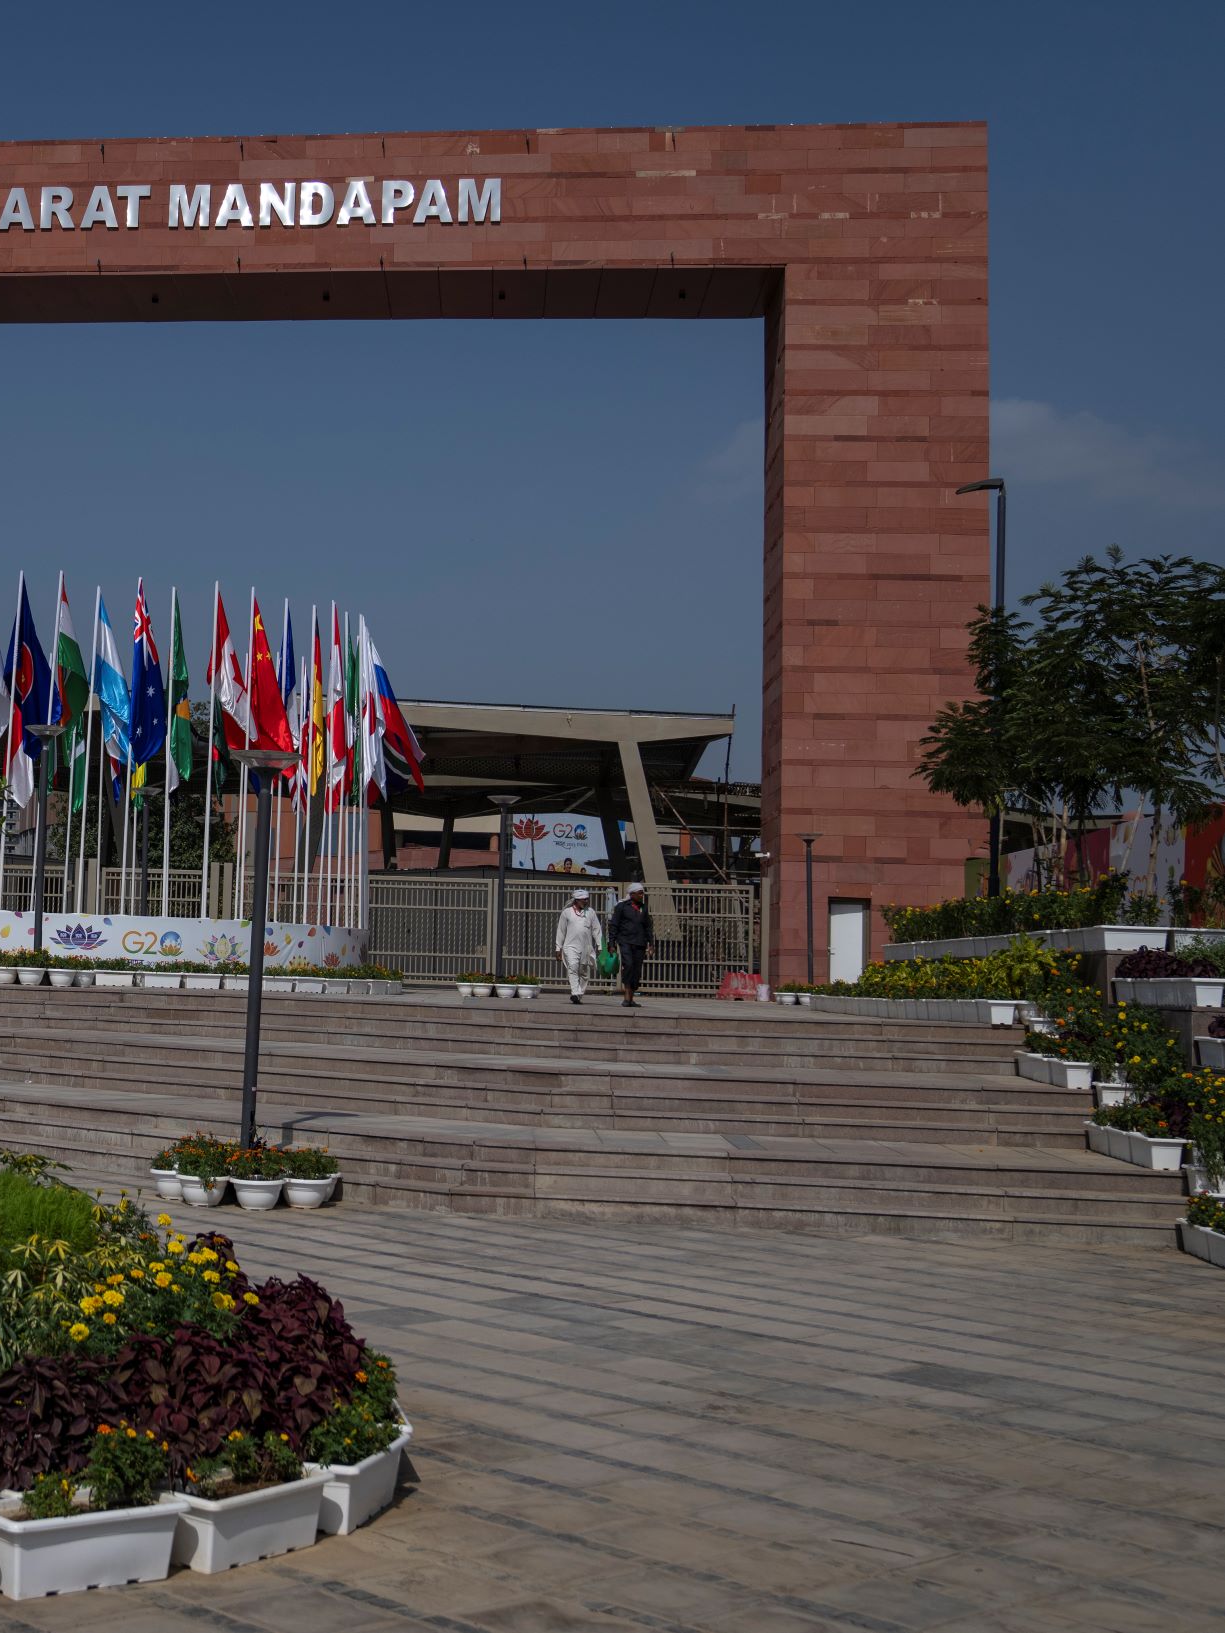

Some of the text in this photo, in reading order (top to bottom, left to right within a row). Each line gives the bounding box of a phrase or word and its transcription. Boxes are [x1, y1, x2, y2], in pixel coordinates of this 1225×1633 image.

[168, 177, 503, 228] MANDAPAM
[552, 823, 588, 840] G20
[121, 930, 183, 956] G20
